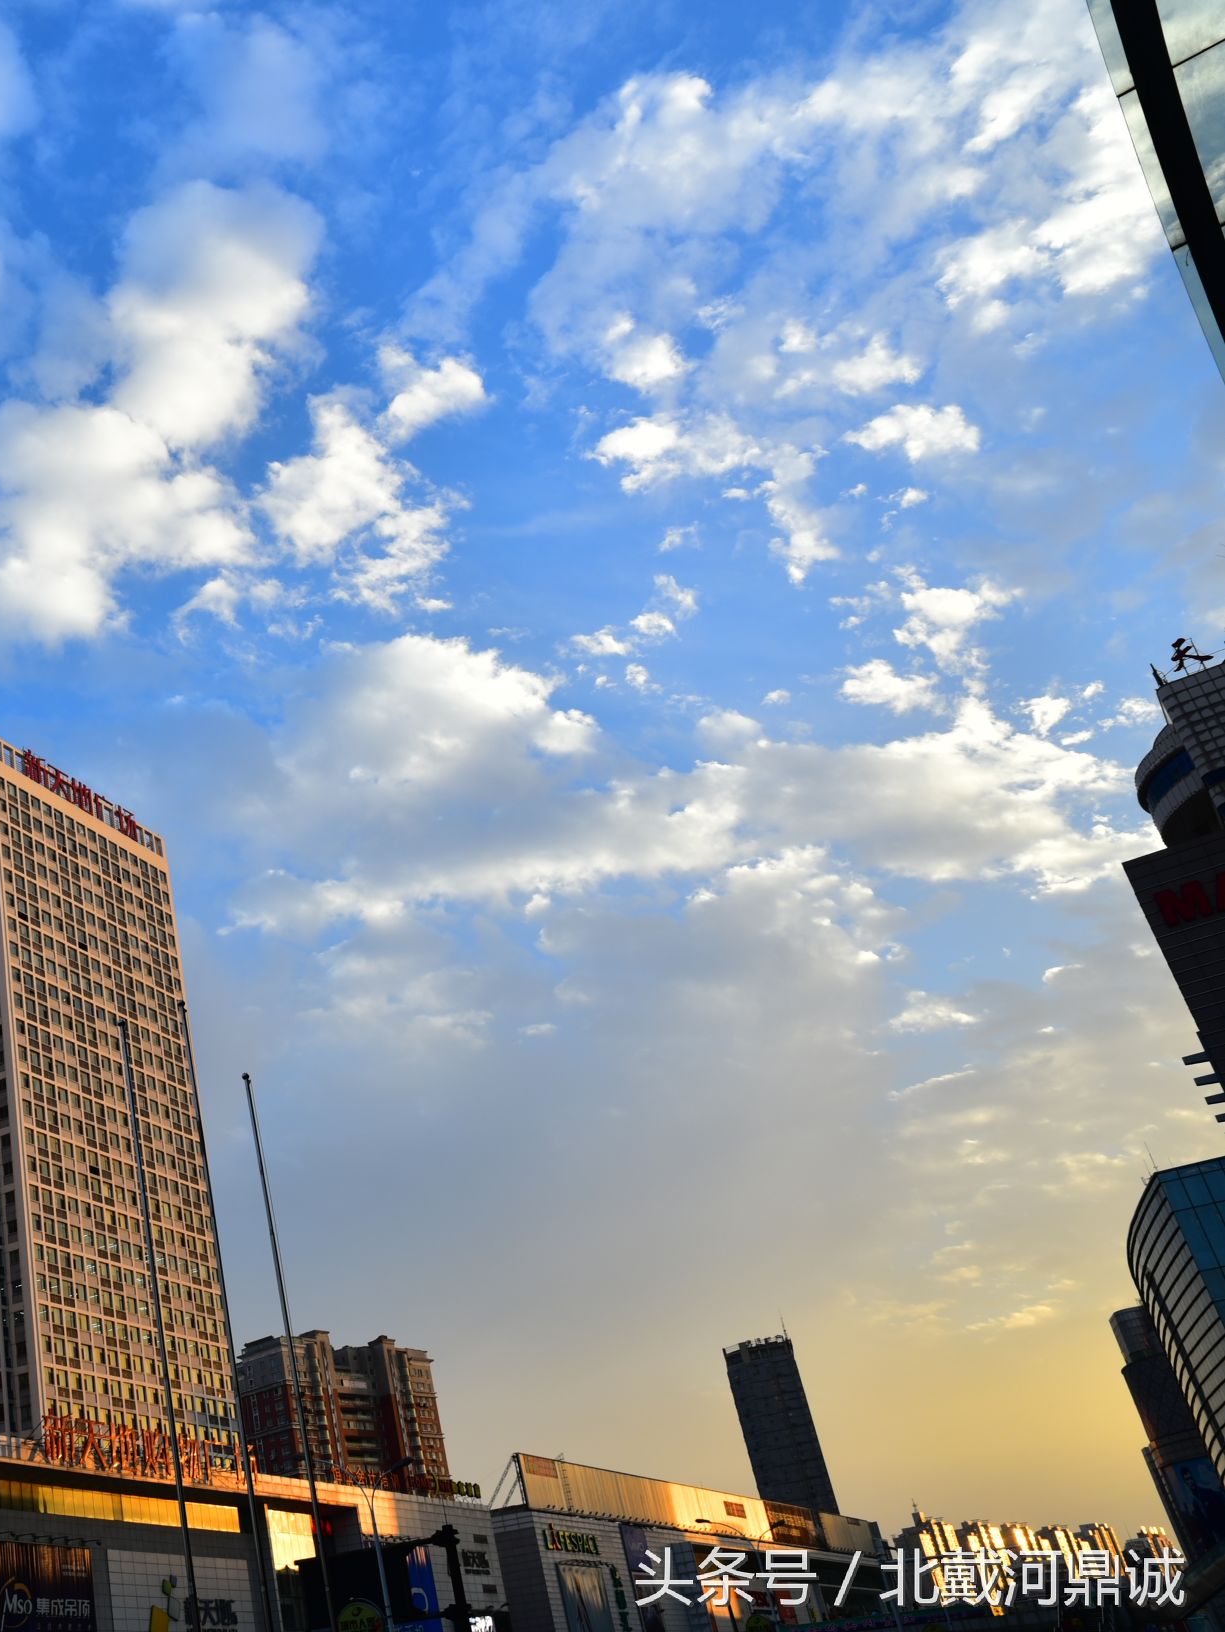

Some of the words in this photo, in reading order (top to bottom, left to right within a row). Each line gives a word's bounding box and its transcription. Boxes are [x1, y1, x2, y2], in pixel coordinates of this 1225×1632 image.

[24, 750, 138, 842] 新天地广场
[35, 1597, 91, 1618] 集成吊顶
